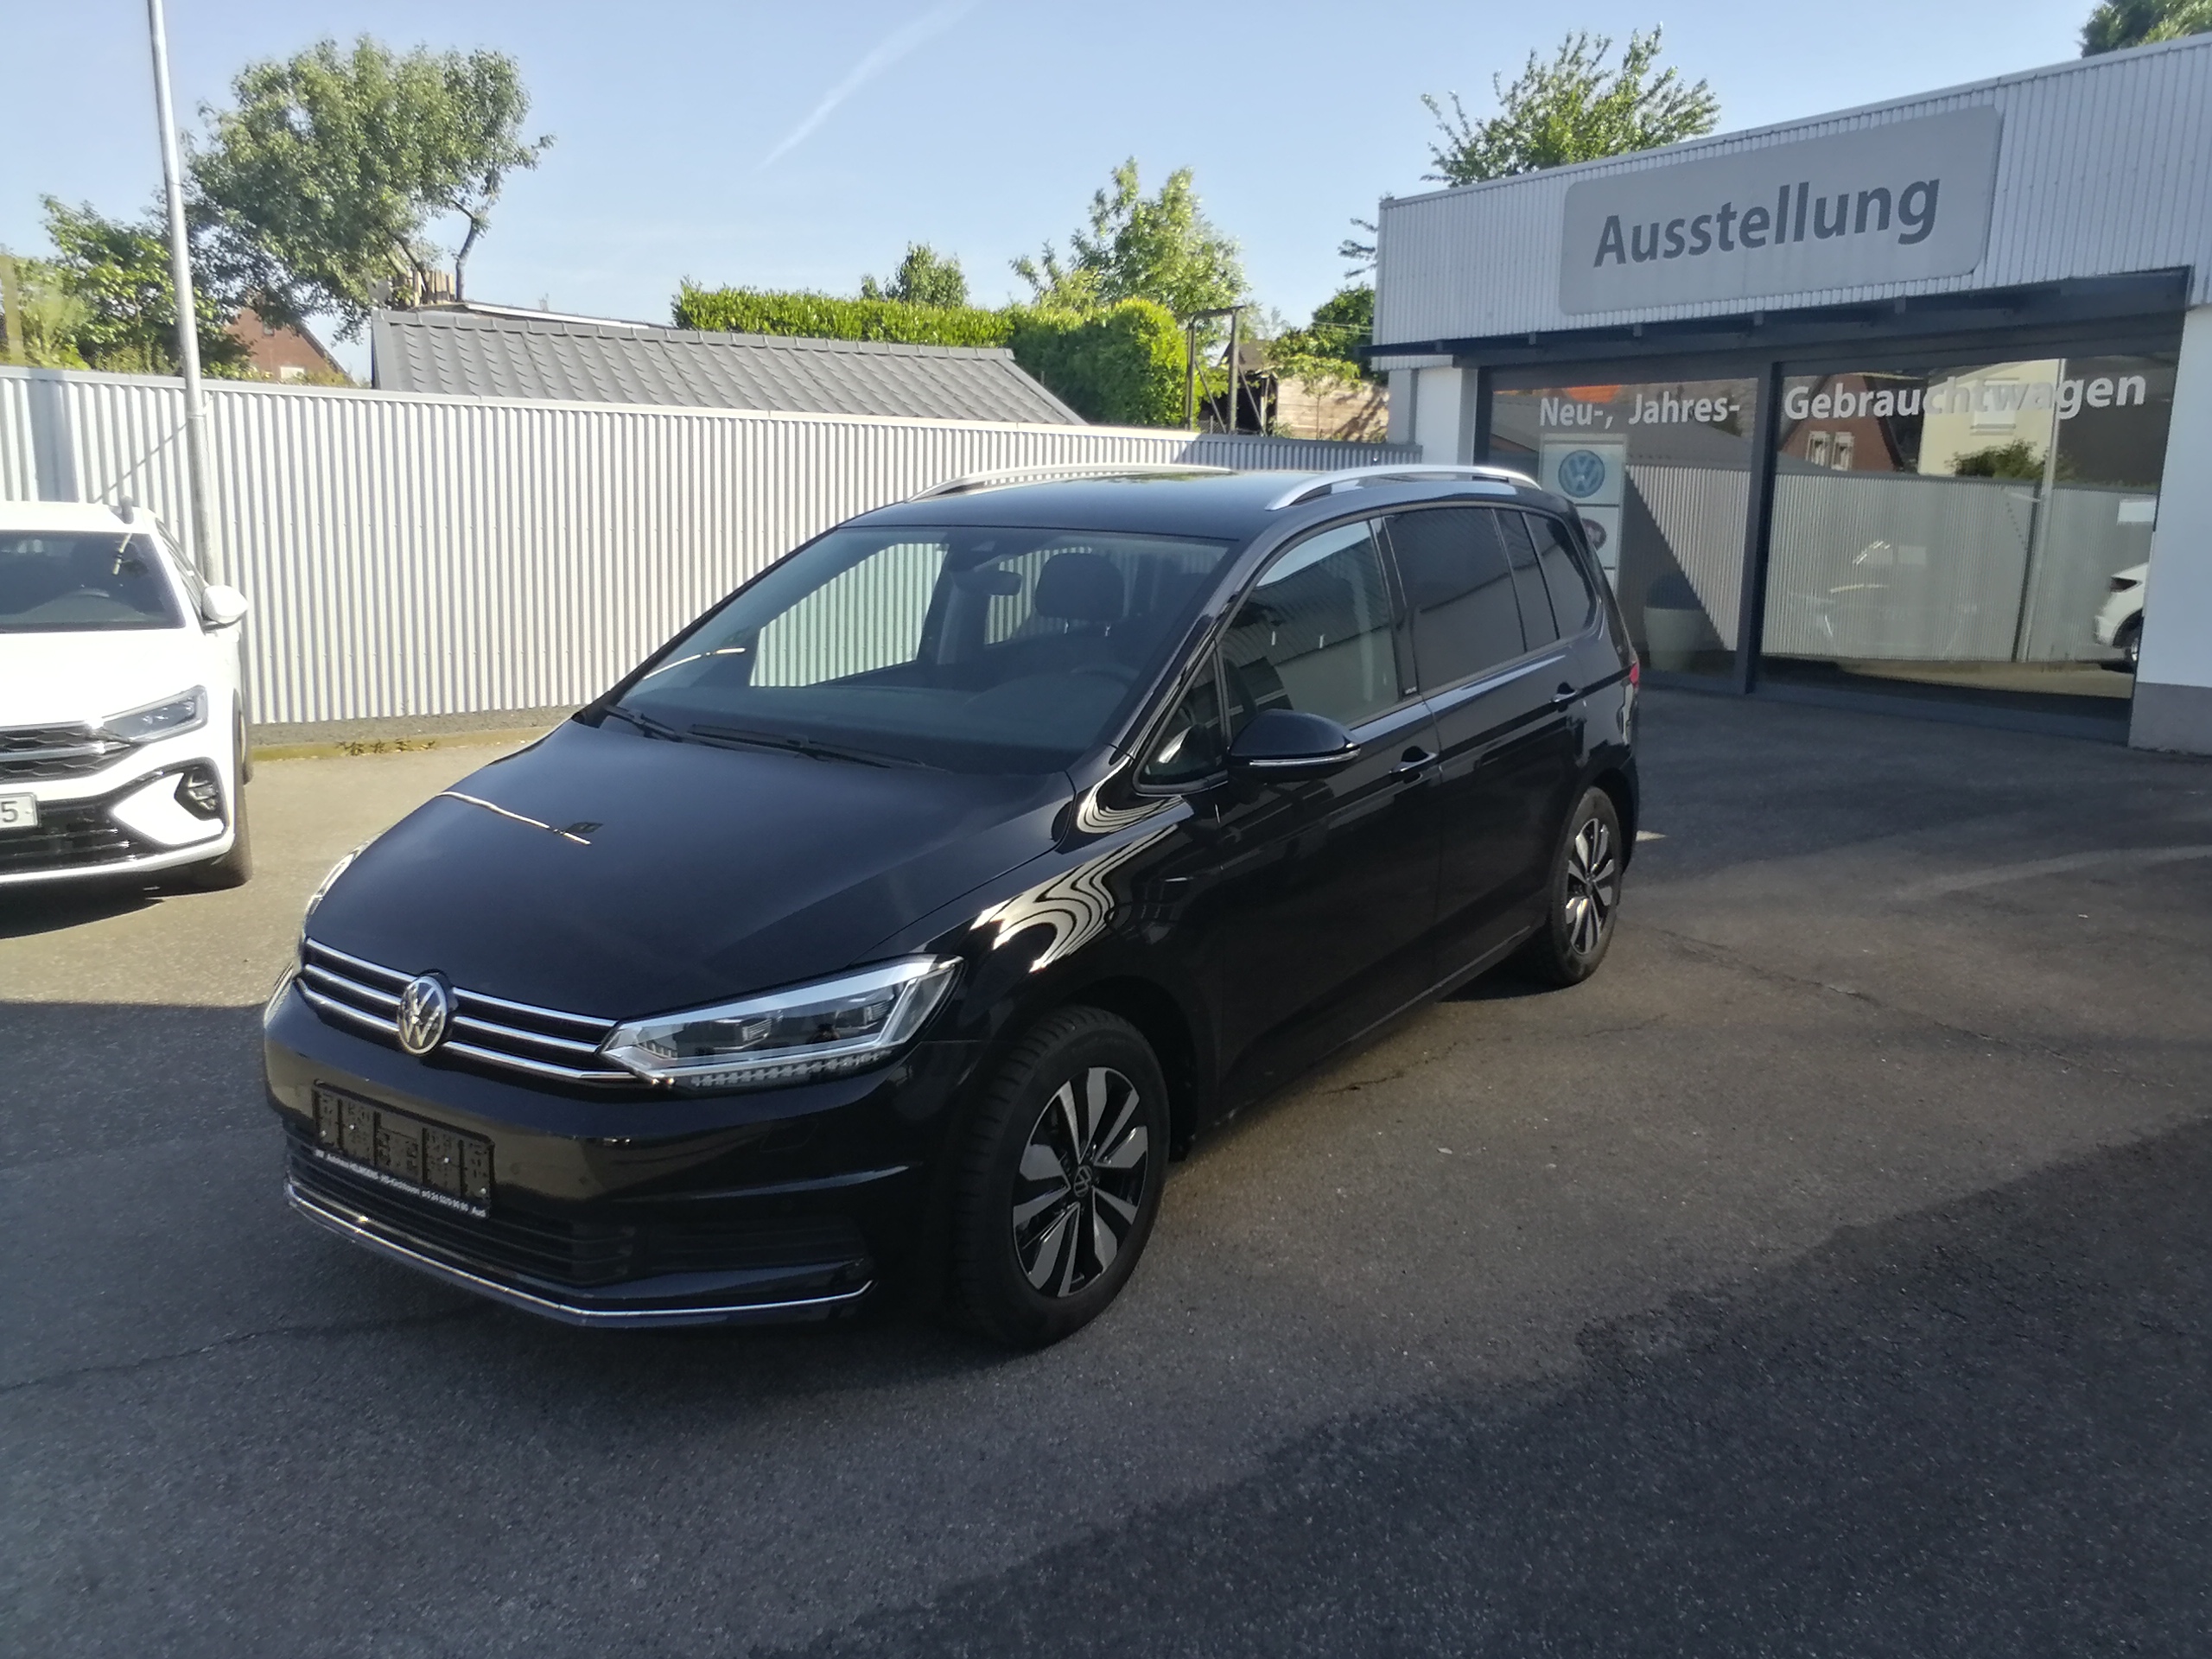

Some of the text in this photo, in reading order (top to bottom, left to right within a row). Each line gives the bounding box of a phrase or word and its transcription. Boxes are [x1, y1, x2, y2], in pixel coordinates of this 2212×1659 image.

[1593, 179, 1940, 268] Ausstellung
[1540, 374, 2146, 429] Neu-, Jahres- Gebrauchtwagen
[1, 800, 19, 823] 5
[397, 976, 446, 1053] VW
